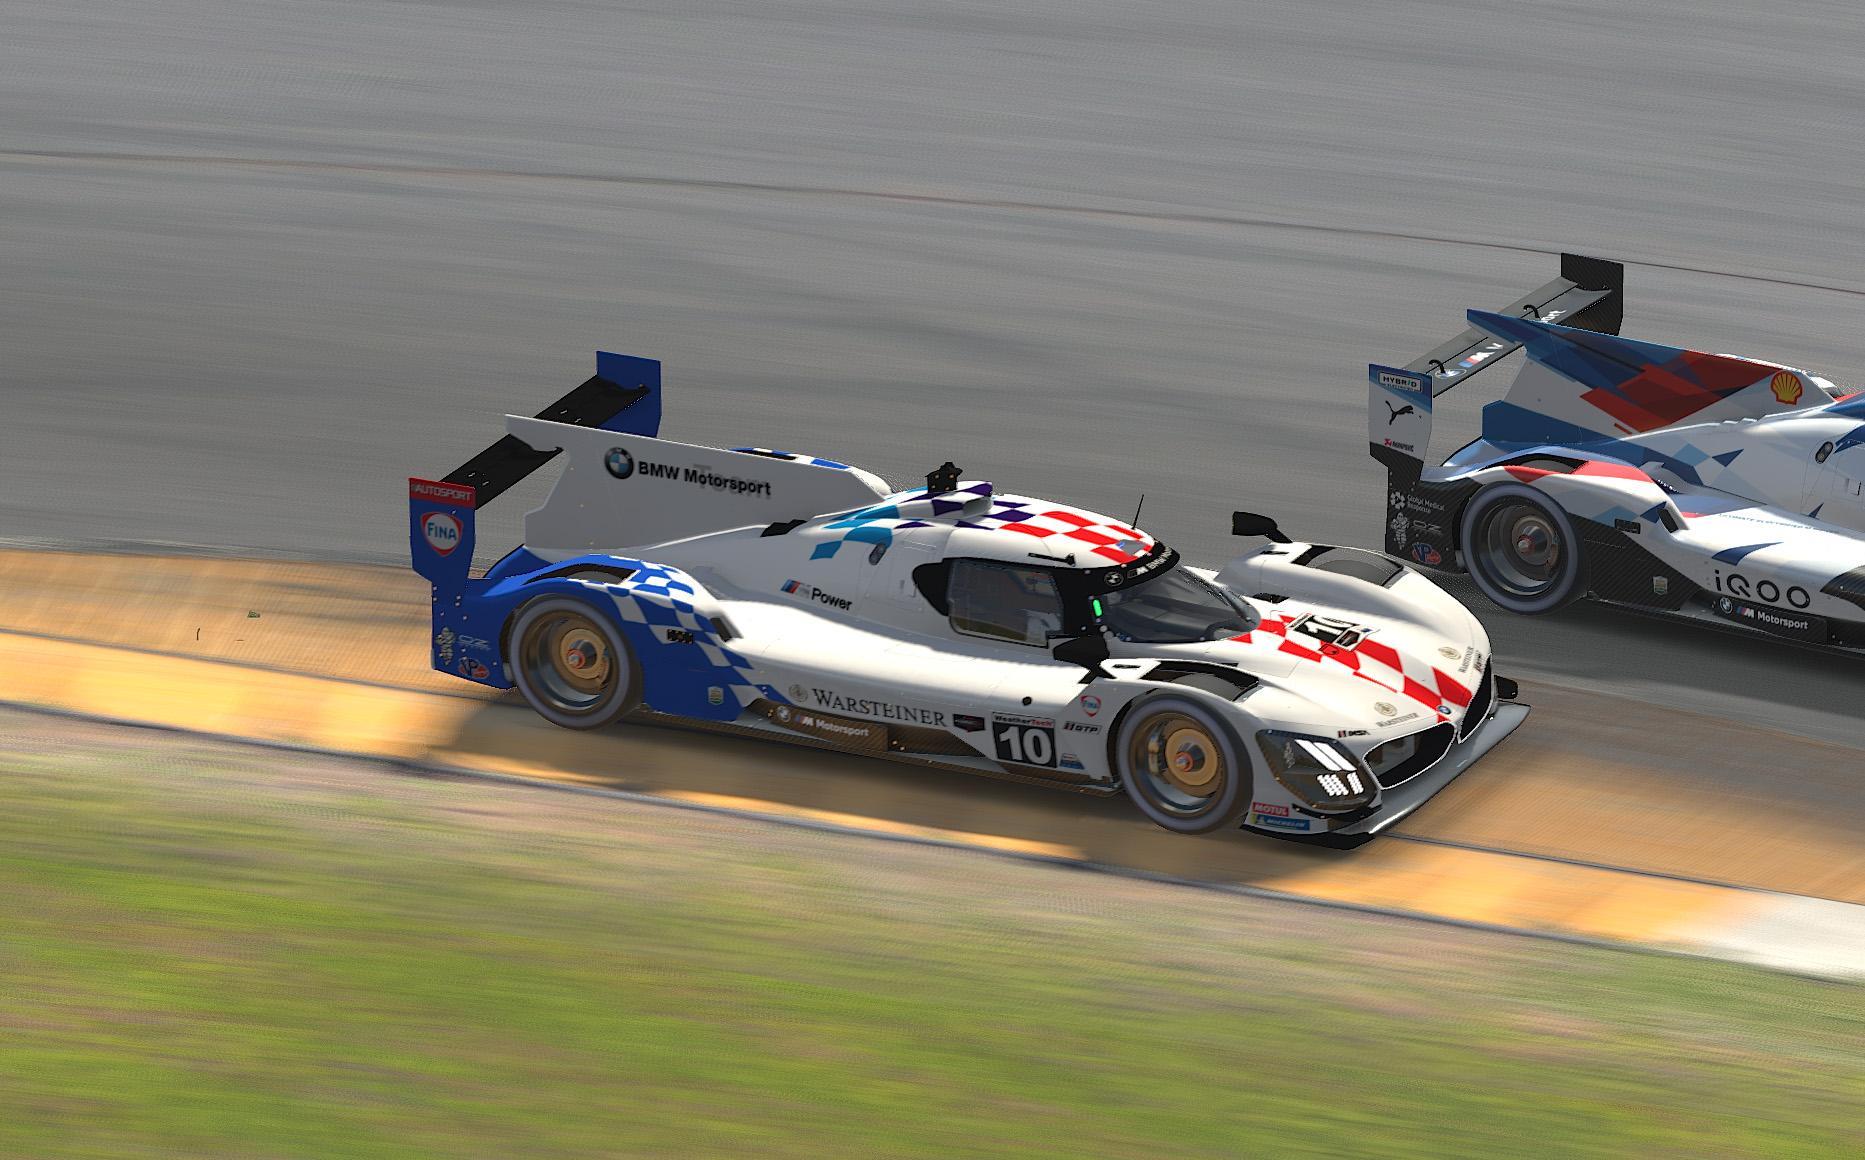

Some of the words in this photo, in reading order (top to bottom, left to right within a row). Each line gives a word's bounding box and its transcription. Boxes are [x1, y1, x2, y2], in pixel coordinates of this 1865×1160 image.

[1383, 376, 1417, 388] HYBRID
[638, 461, 680, 480] BMW
[684, 468, 771, 496] Motorsport
[427, 522, 457, 541] FINA
[811, 587, 853, 611] Power
[1757, 610, 1809, 630] Motorsport
[812, 688, 947, 727] WARSTEINER
[816, 719, 870, 737] Motorsport
[1075, 725, 1099, 733] GTP
[1000, 725, 1051, 765] 10
[1254, 804, 1288, 816] MOTUL
